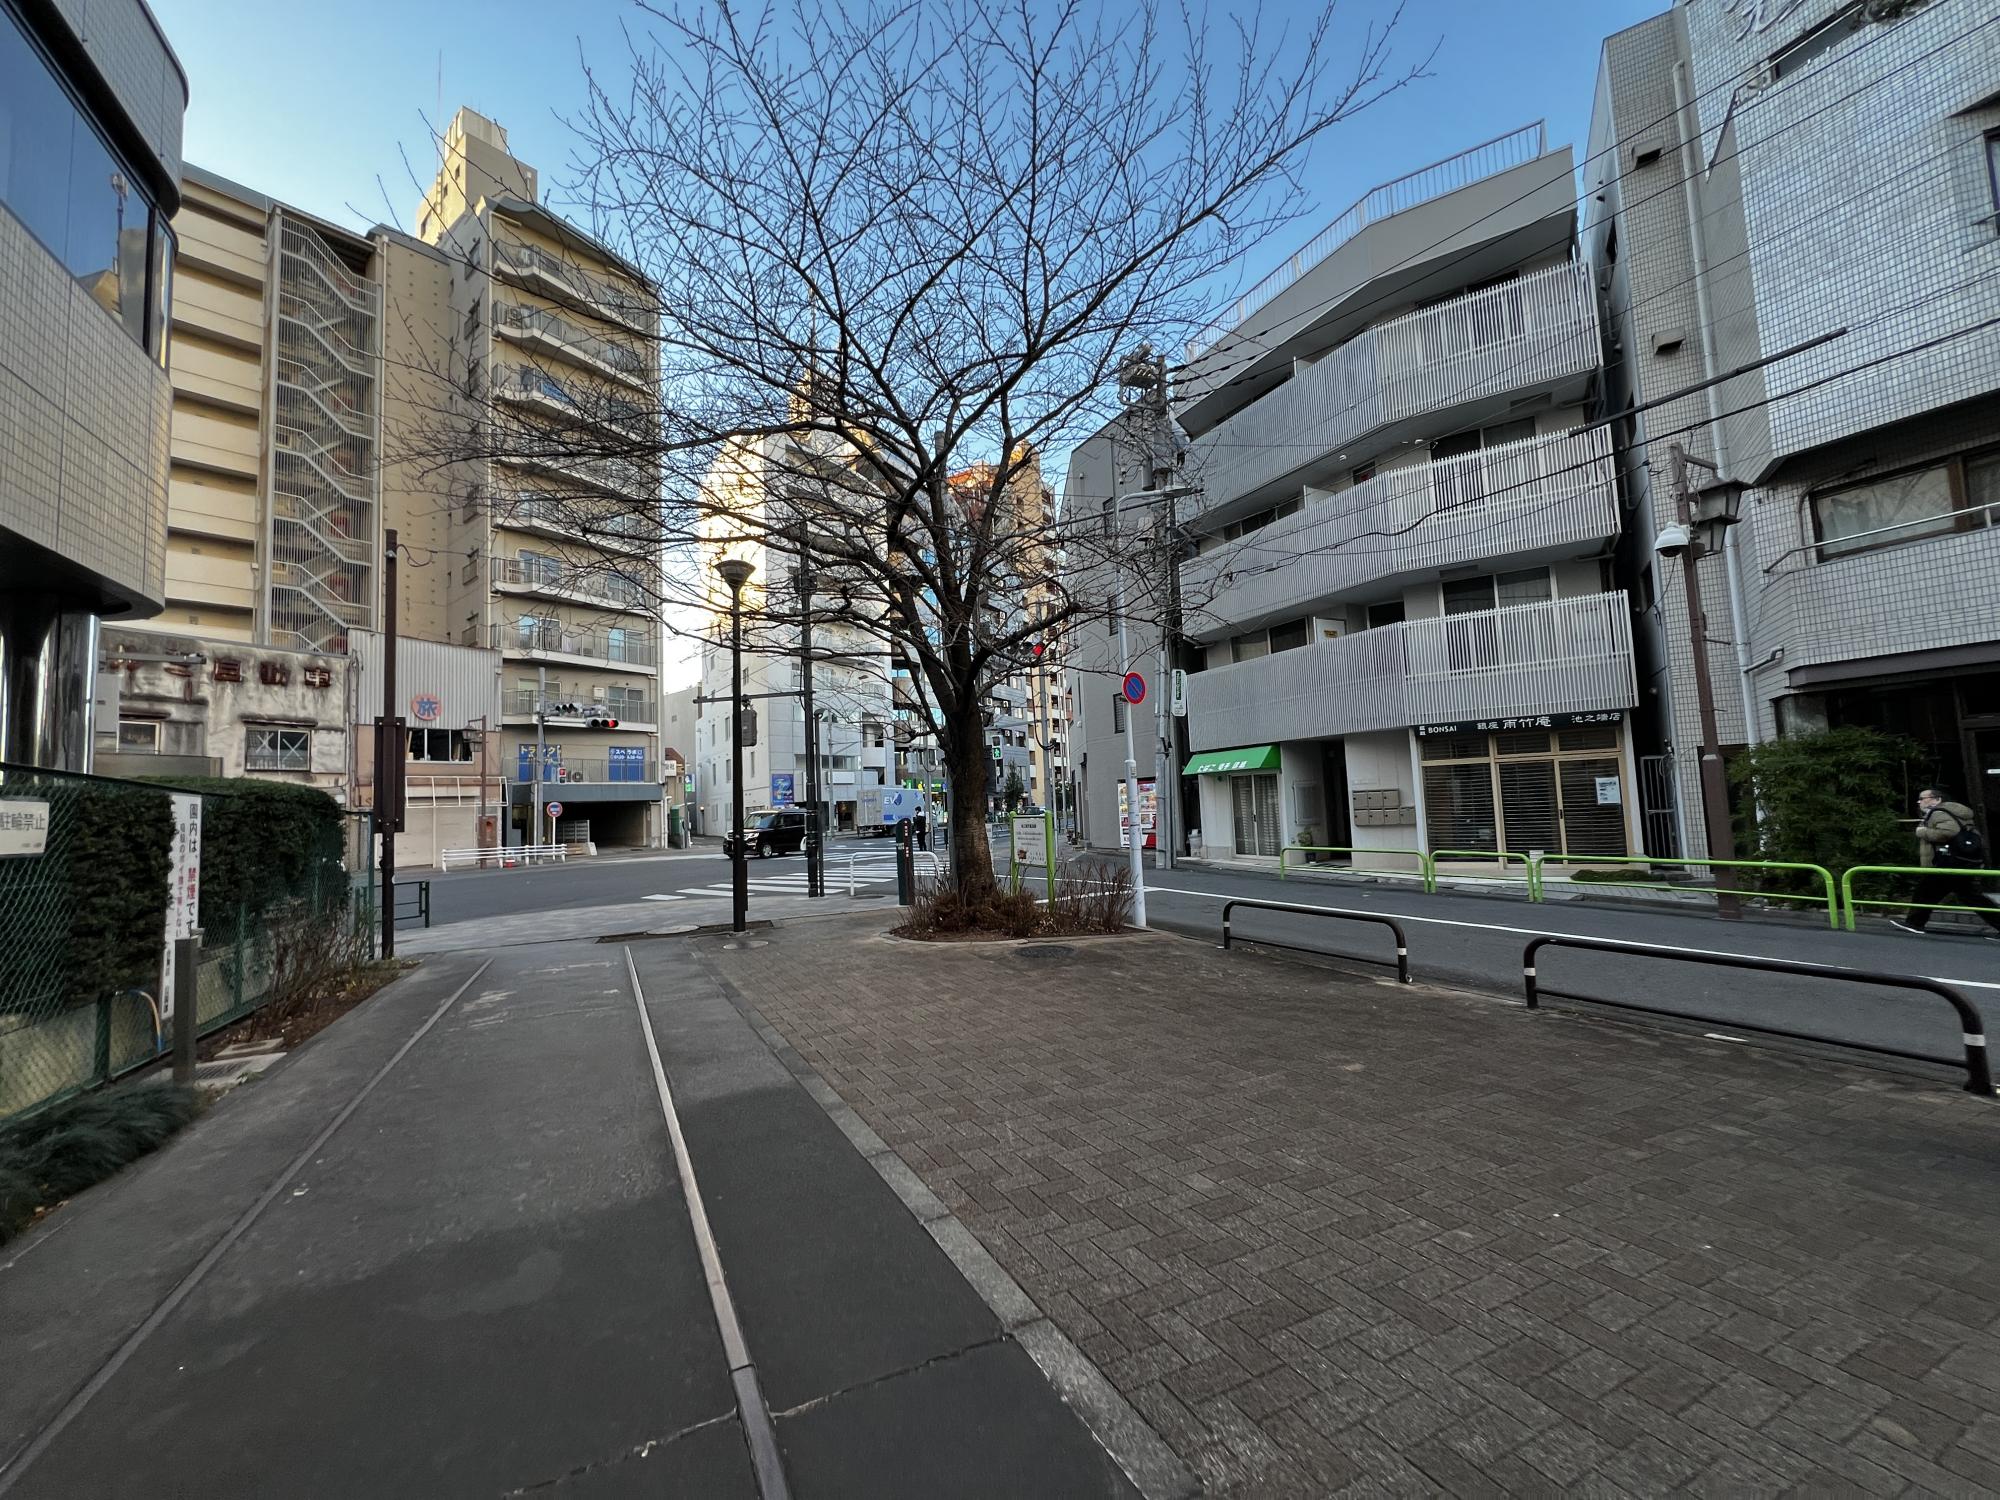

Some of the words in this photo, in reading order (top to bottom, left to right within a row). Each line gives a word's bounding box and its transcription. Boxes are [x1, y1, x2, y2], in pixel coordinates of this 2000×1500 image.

[1502, 716, 1551, 729] 雨竹庵
[1571, 712, 1621, 724] 池之端店
[1428, 725, 1457, 734] BONSAI
